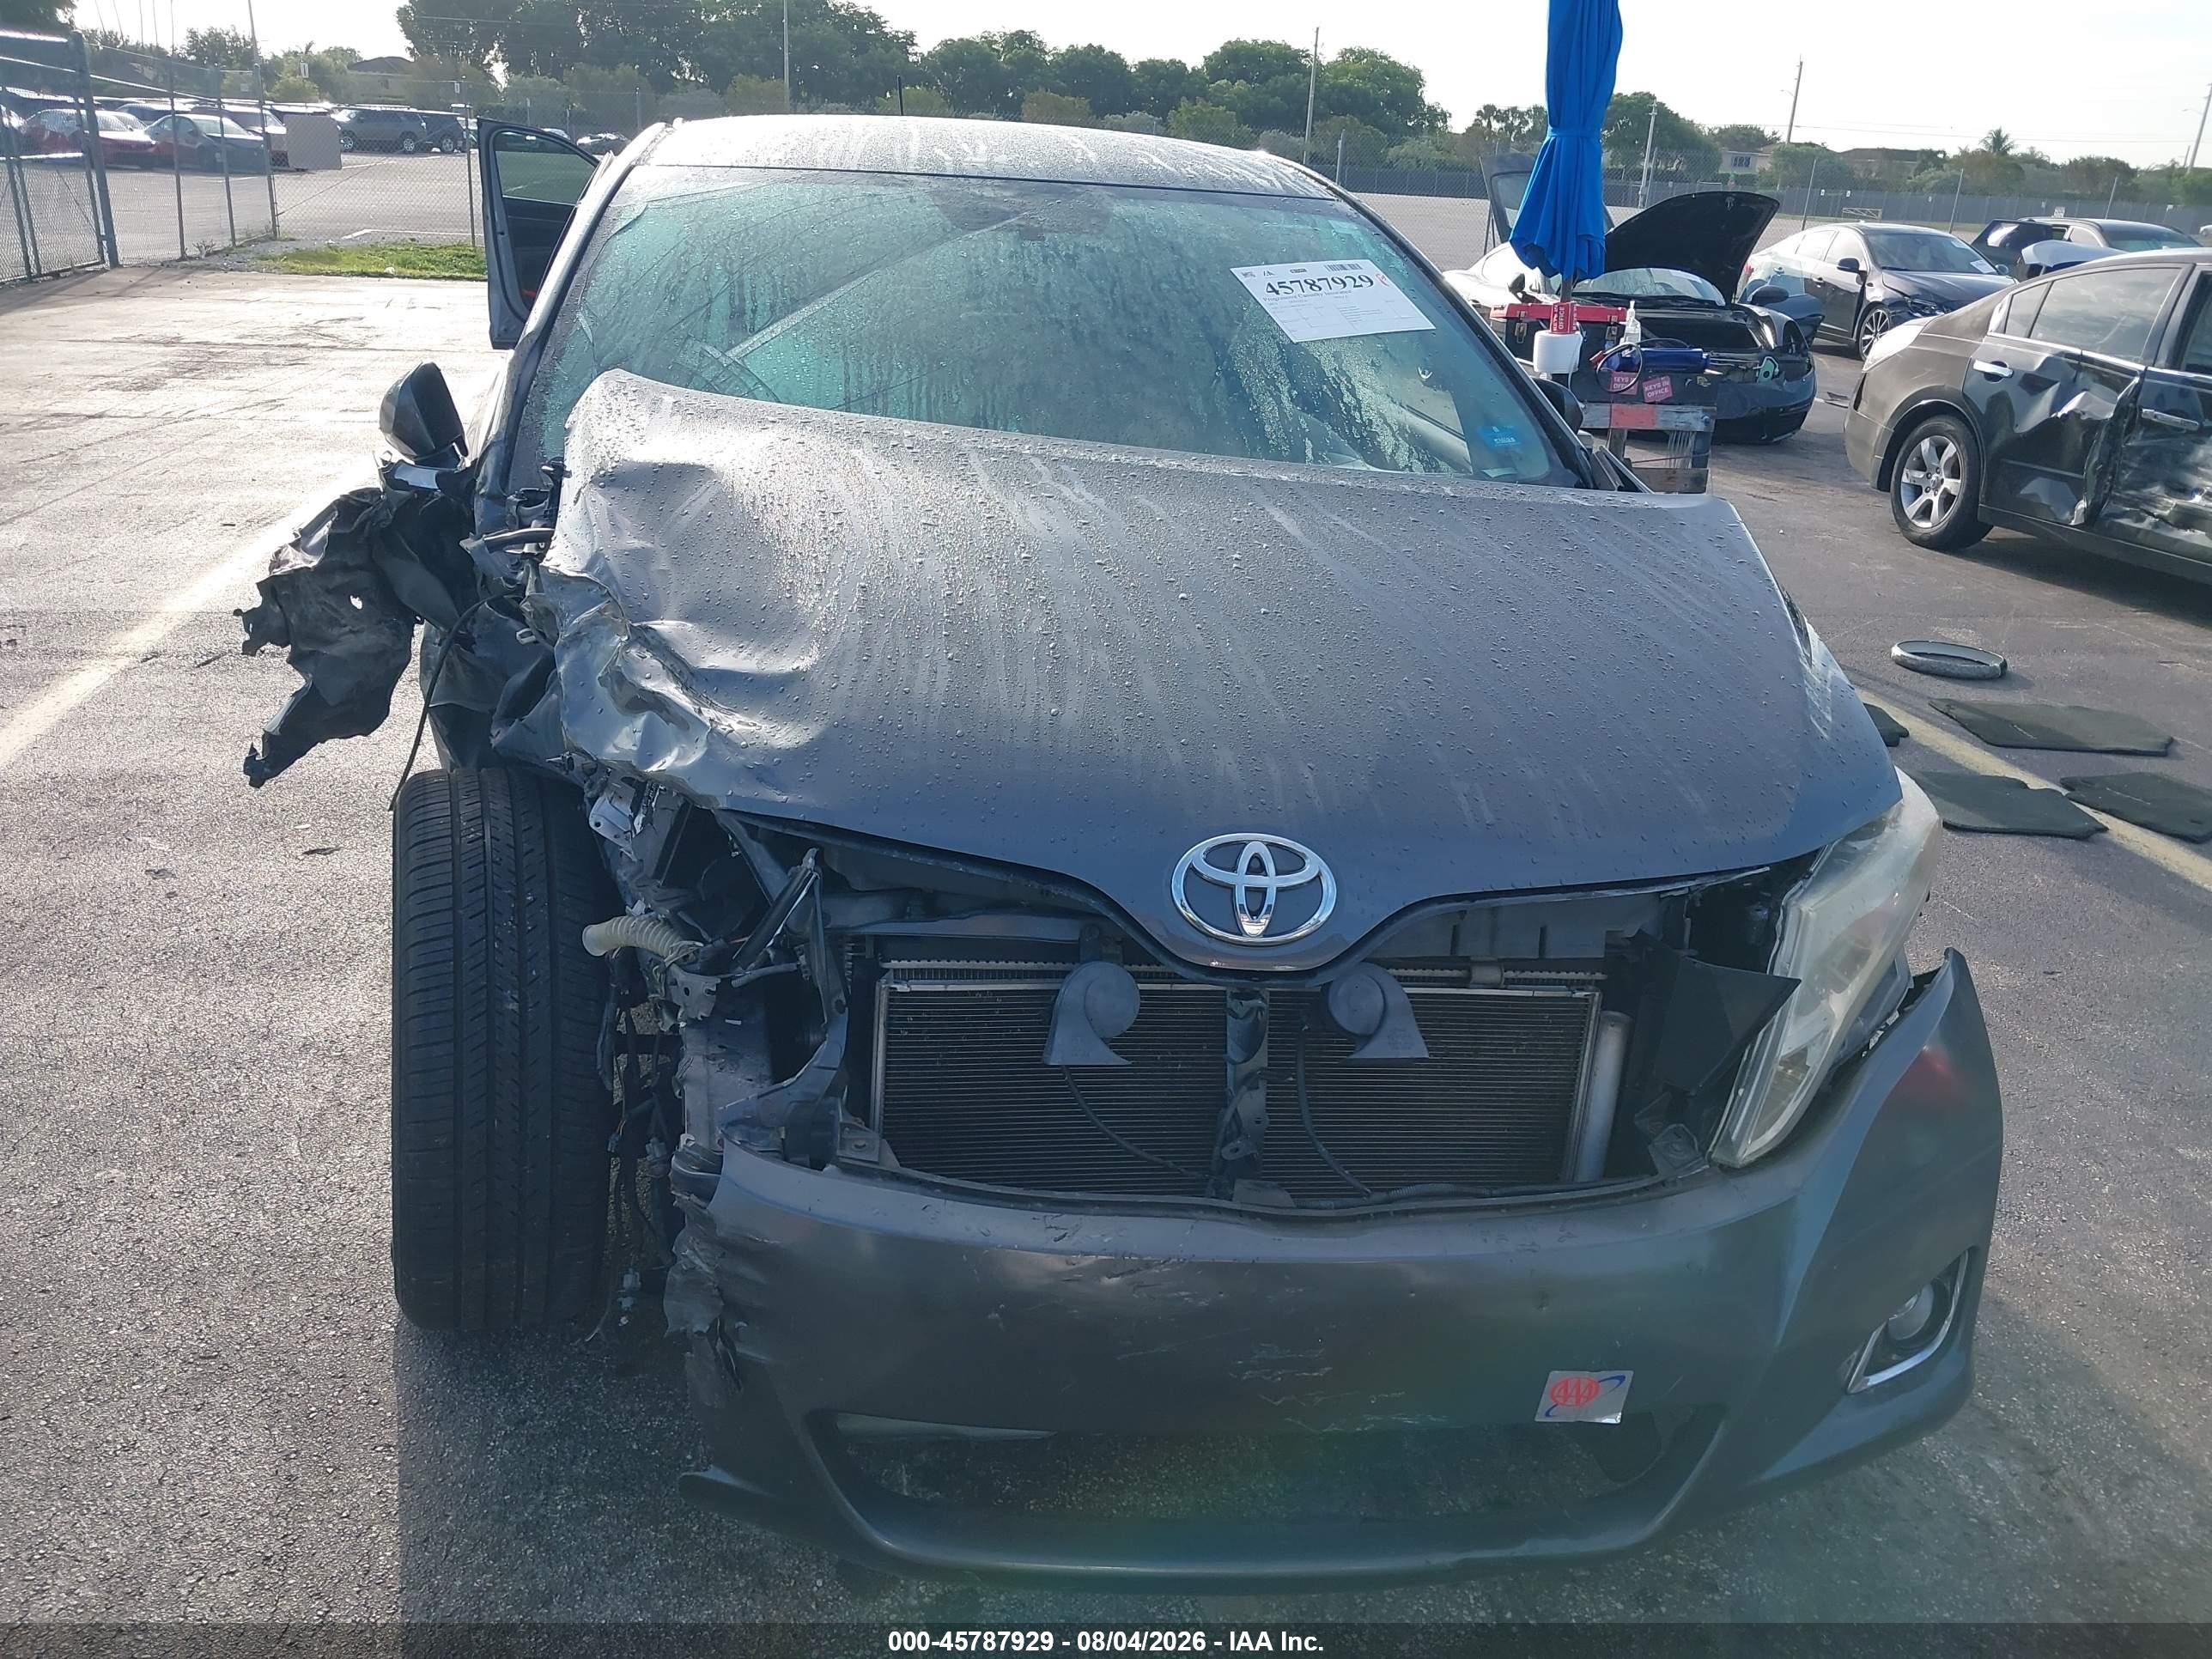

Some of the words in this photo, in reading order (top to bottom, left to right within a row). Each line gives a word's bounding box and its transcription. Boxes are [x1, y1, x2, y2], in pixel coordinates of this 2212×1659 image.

[1266, 274, 1374, 295] 45787929
[1644, 382, 1662, 392] KEYS
[1647, 386, 1669, 398] OFFICE
[1551, 1376, 1599, 1407] AAA
